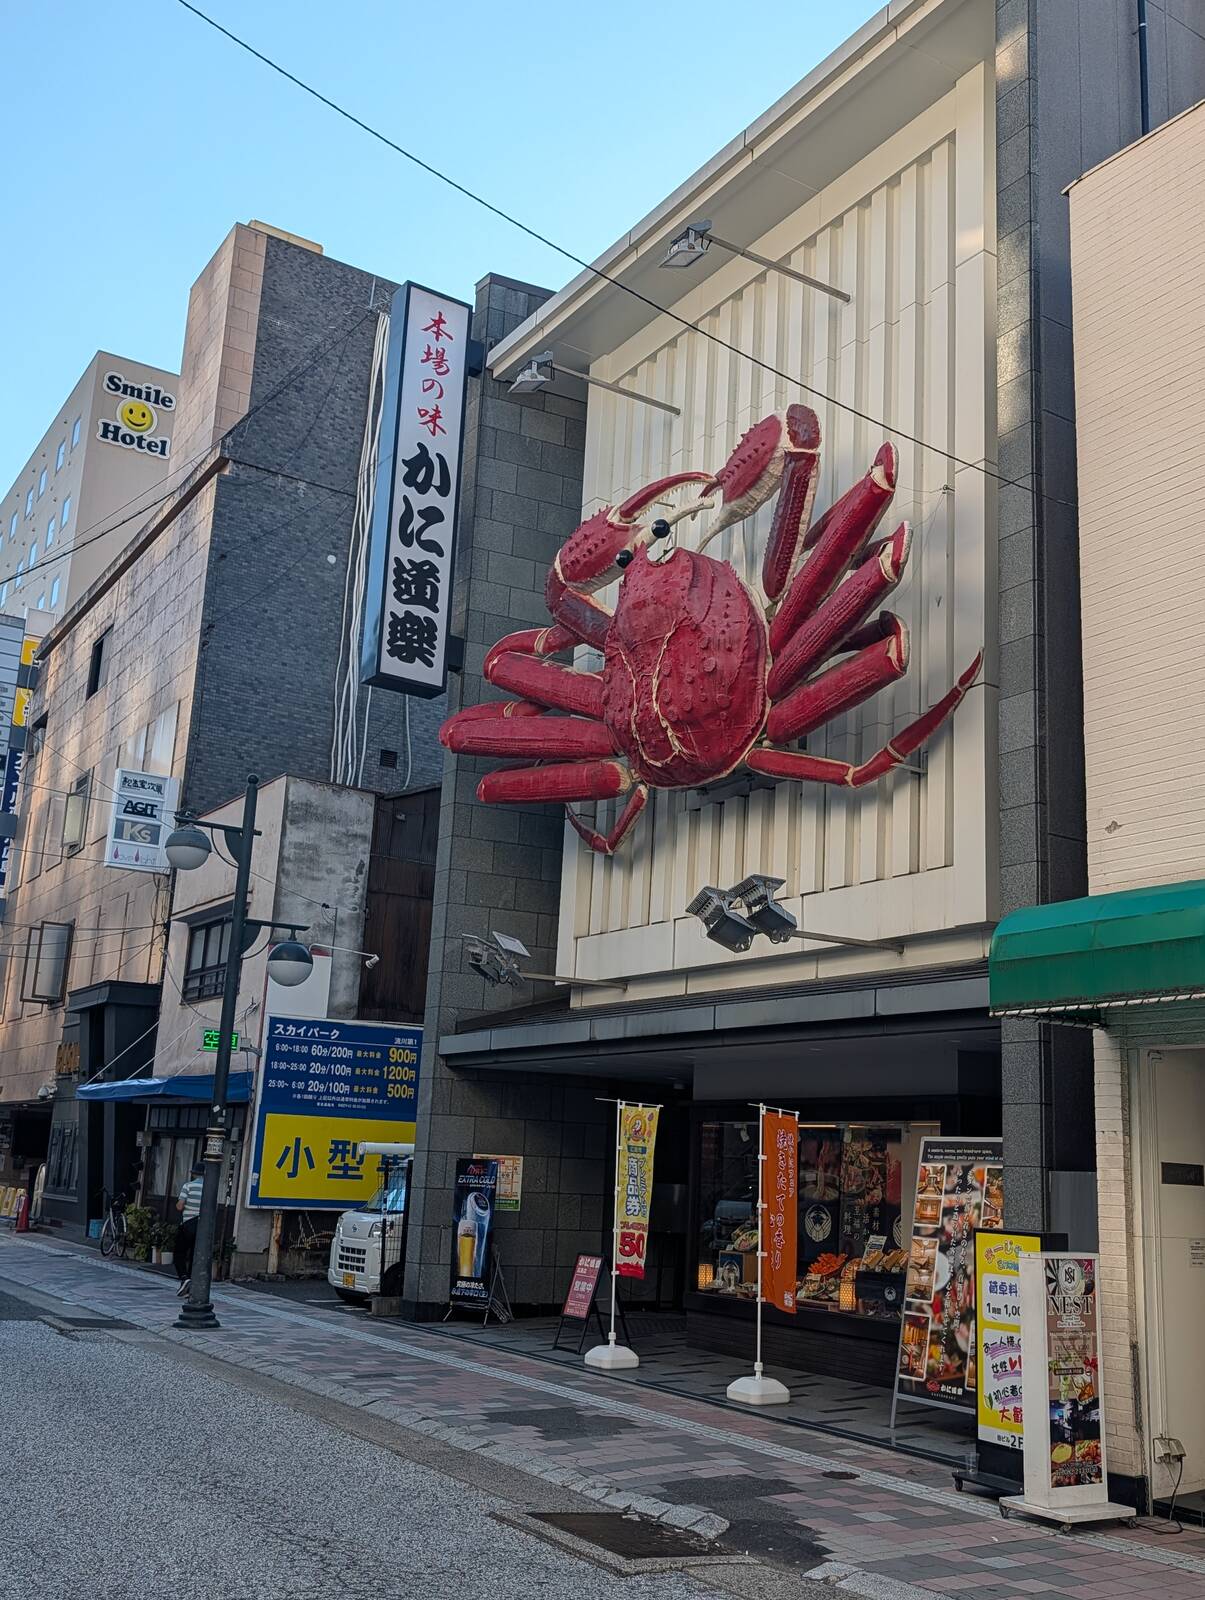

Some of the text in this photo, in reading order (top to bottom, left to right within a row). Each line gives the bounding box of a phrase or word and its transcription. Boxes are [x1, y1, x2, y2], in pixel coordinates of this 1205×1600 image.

[417, 311, 454, 437] 本場の味
[106, 374, 174, 409] Smile
[100, 421, 170, 457] Hotel
[274, 1023, 340, 1040] スカイパーク
[311, 1044, 353, 1059] 60分/200円
[356, 1050, 382, 1059] 最大料金
[389, 1047, 417, 1064] 900円
[309, 1062, 352, 1077] 20分/100円
[354, 1067, 380, 1077] 最大料金
[383, 1065, 416, 1082] 1200円
[307, 1080, 350, 1095] 20分/100円
[353, 1085, 378, 1094] 最大料金
[387, 1083, 415, 1099] 500円
[458, 1175, 496, 1184] EXTRA COLD
[626, 1156, 641, 1216] 商品券
[989, 1280, 1020, 1298] 貸卓料
[1048, 1295, 1093, 1316] NEST
[991, 1360, 1008, 1374] 女性
[1010, 1434, 1023, 1449] 2F
